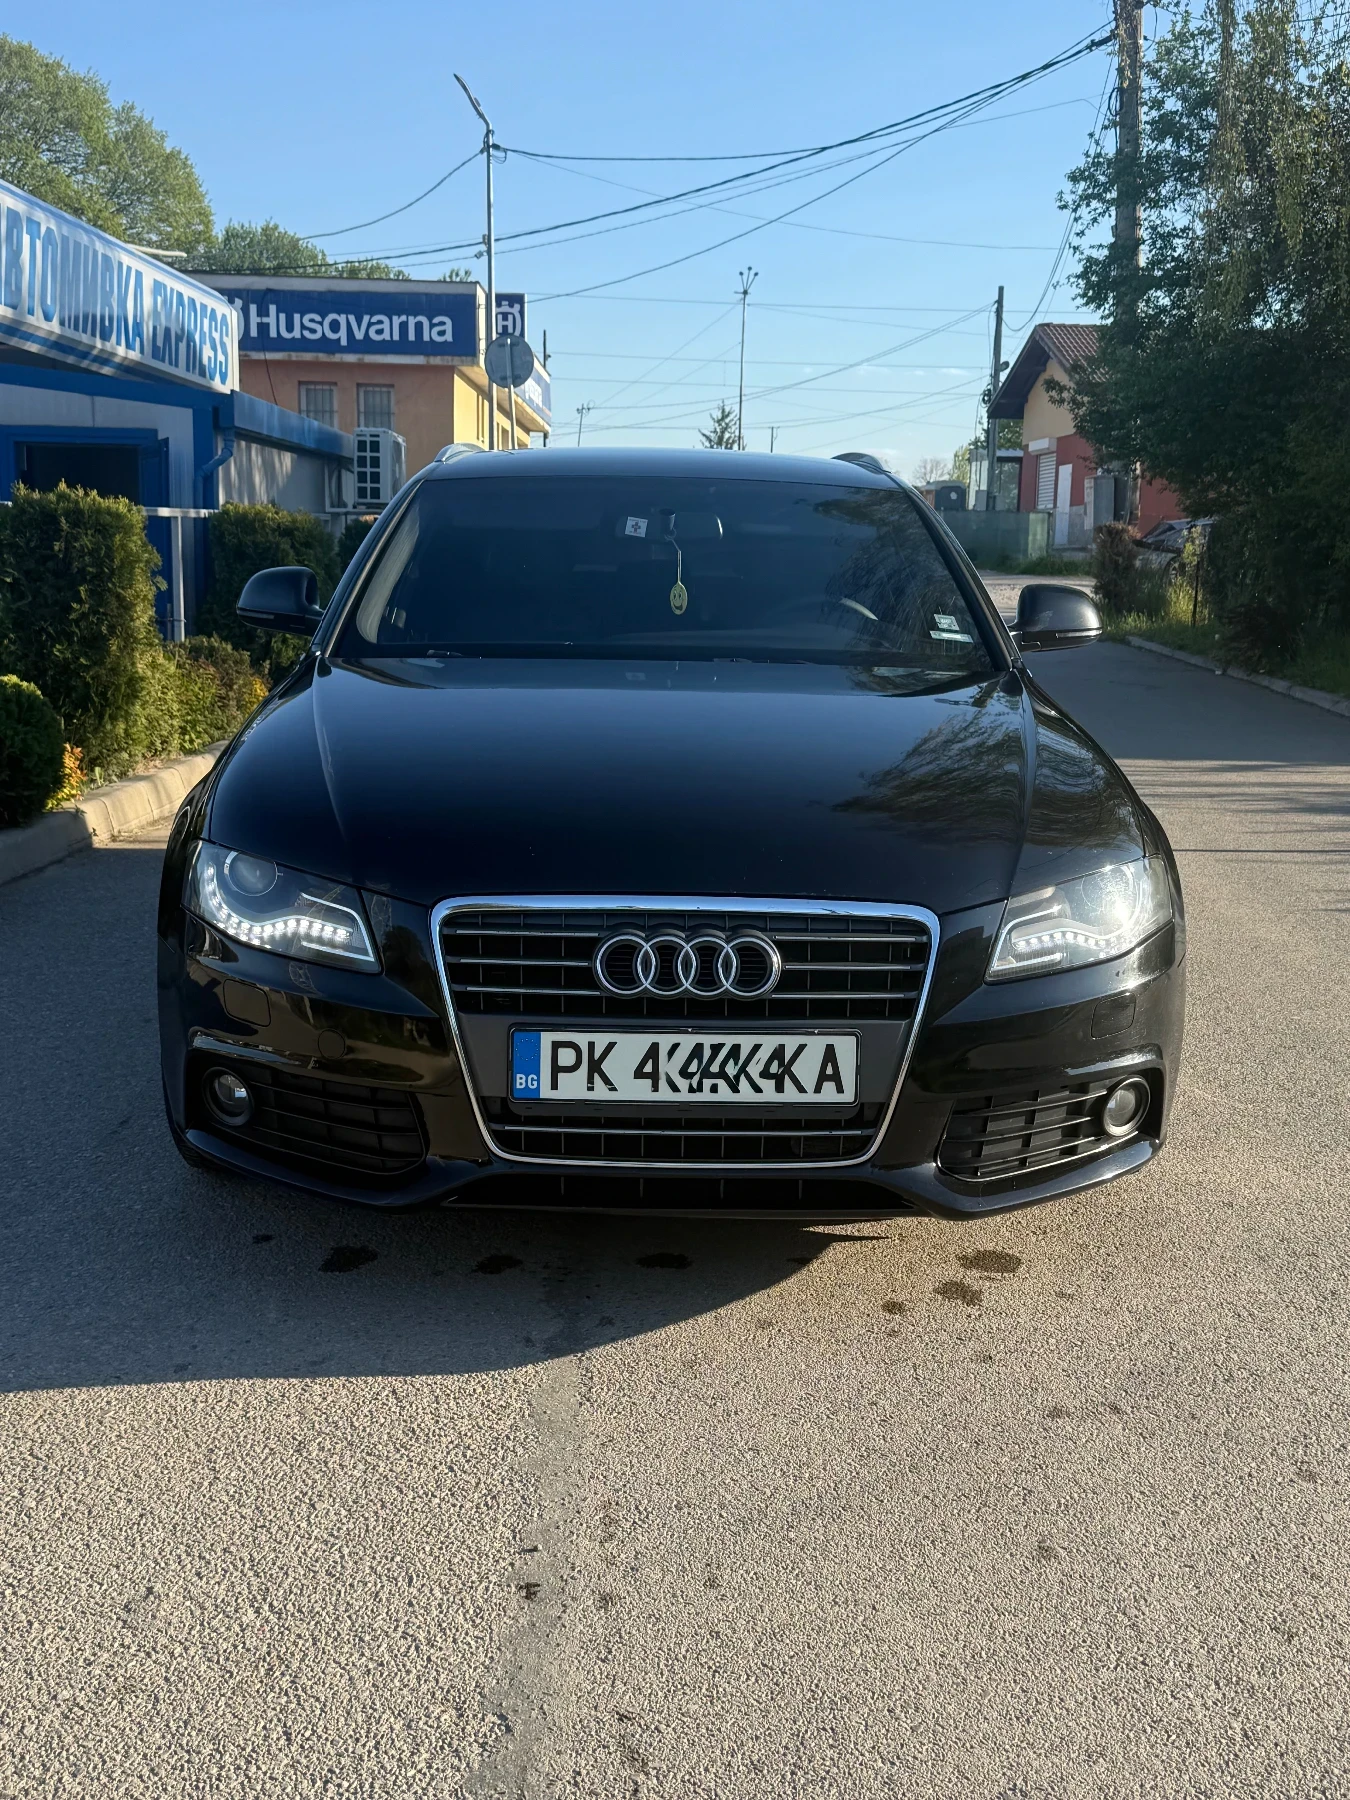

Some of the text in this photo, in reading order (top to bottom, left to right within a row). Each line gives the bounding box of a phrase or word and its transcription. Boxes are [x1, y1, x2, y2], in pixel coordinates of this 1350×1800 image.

[0, 203, 230, 386] ВТОМИВКА EXPRESS
[249, 303, 453, 346] Husqvarna
[515, 1073, 538, 1089] BG
